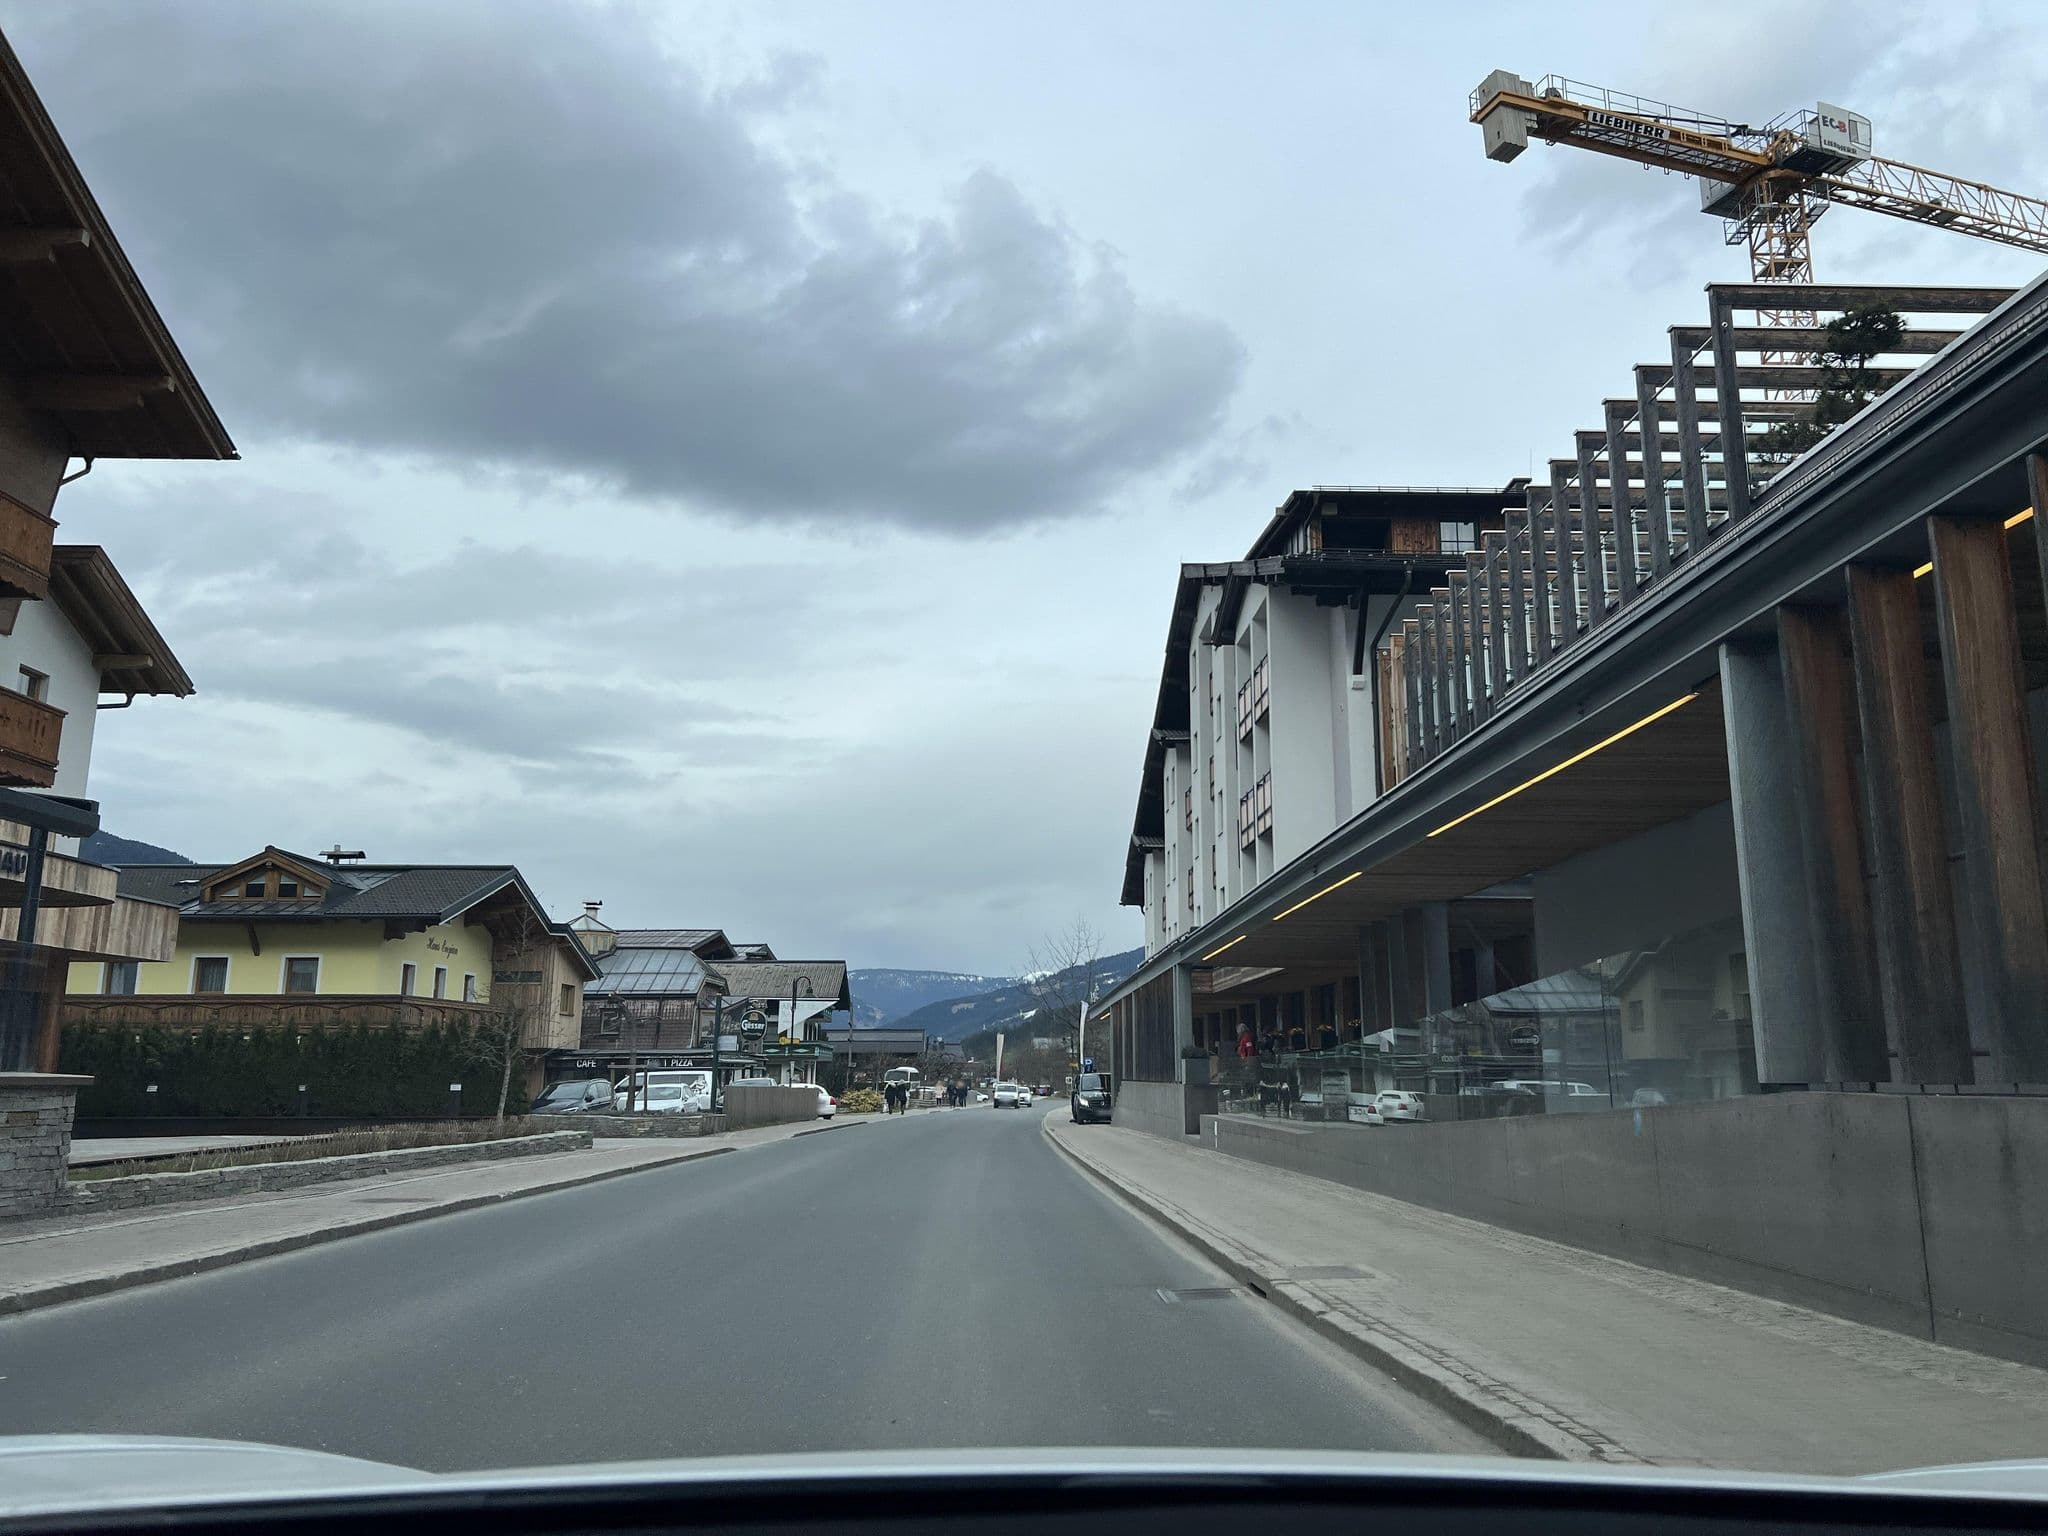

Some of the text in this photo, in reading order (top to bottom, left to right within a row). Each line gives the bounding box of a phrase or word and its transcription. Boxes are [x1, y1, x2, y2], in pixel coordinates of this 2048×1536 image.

[1592, 112, 1664, 138] LIEBHERR
[1822, 115, 1847, 133] EC-B
[670, 1058, 693, 1067] PIZZA
